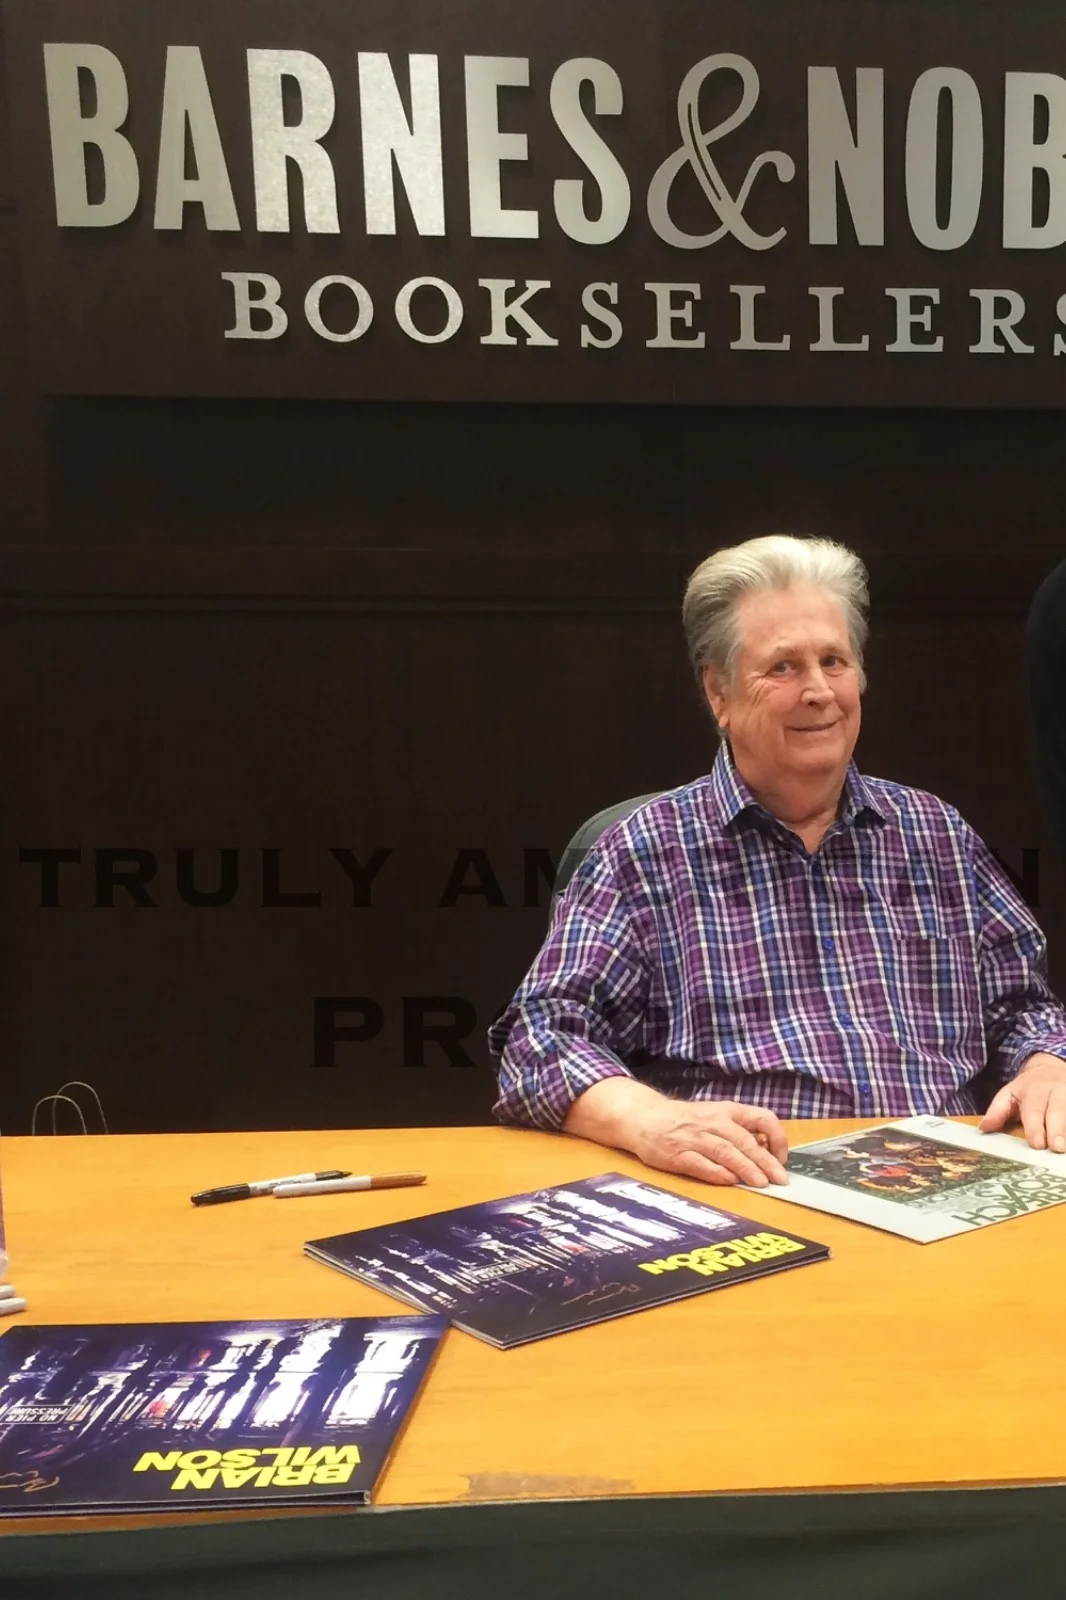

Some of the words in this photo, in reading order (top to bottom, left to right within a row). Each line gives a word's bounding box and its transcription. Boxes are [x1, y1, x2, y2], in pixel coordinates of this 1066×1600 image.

[951, 1190, 1066, 1226] BEACH
[637, 1232, 789, 1275] WILSON
[687, 1239, 806, 1276] BRIAN
[133, 1444, 361, 1476] WILSON
[171, 1462, 356, 1491] BRIAN
